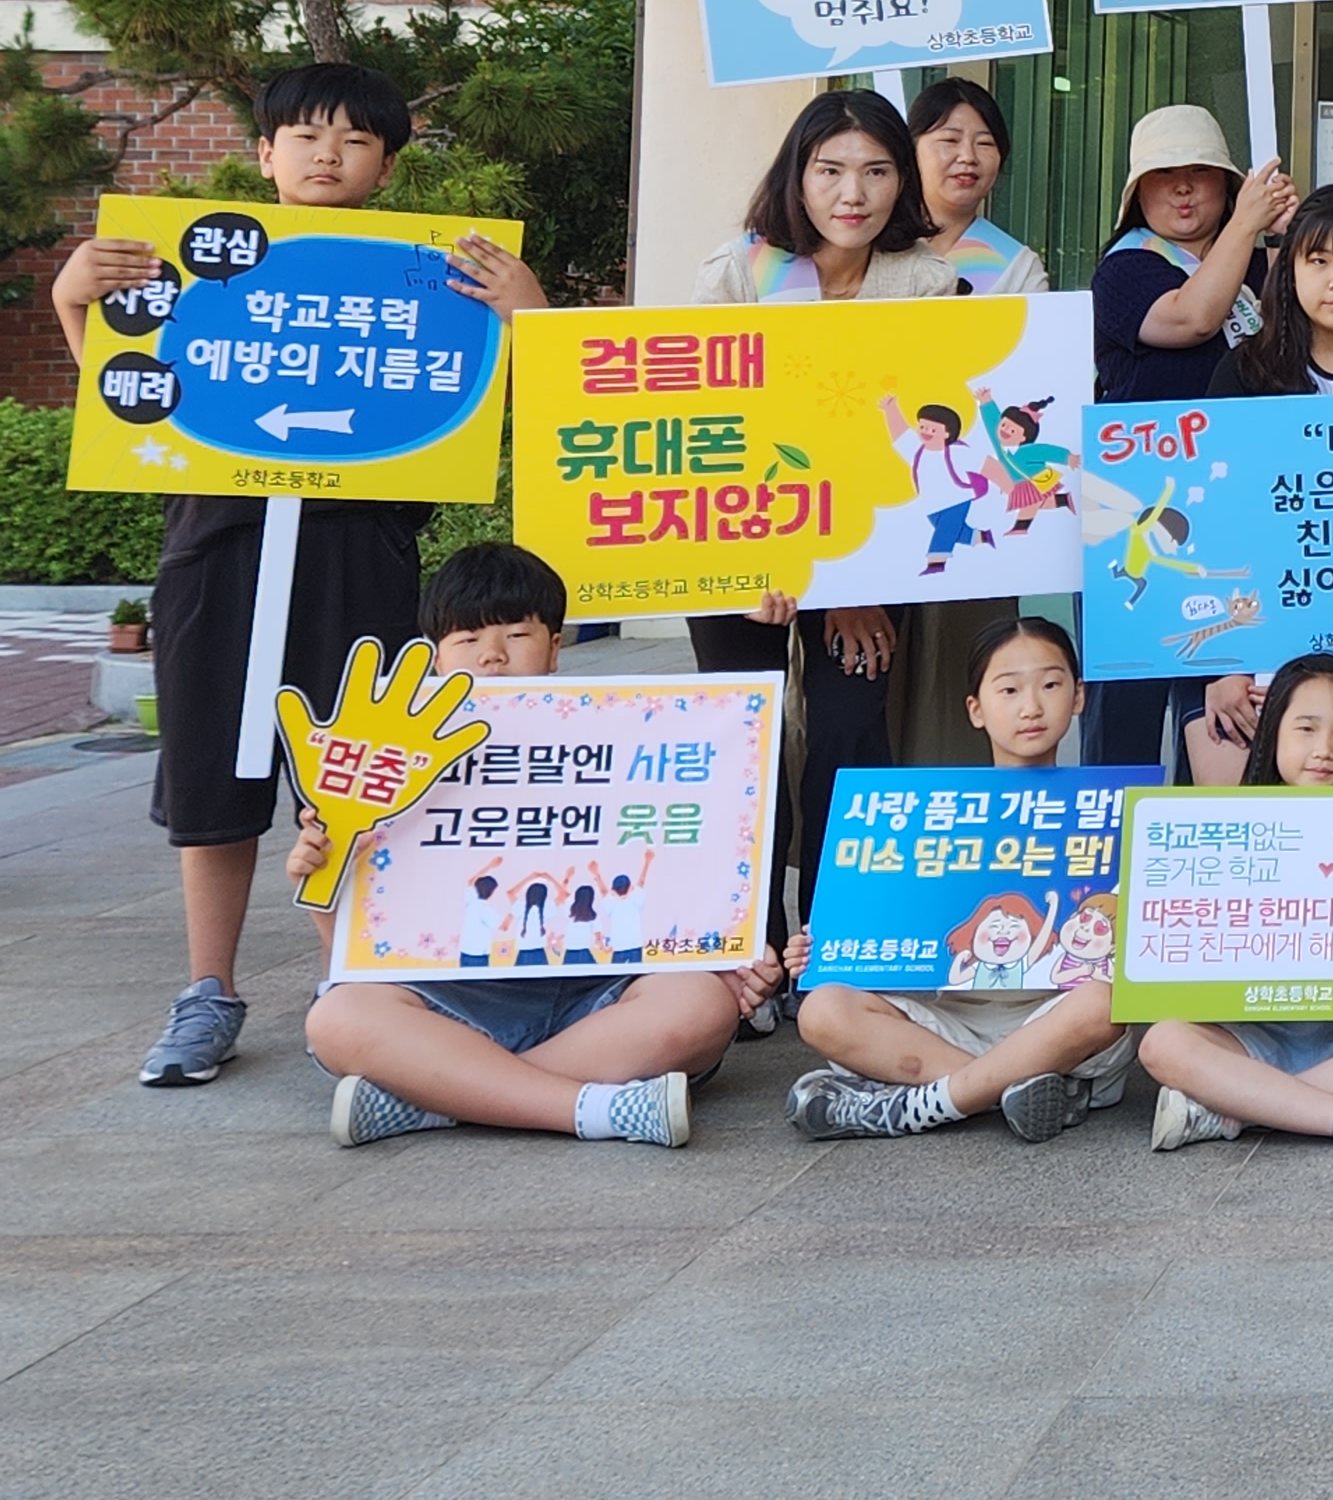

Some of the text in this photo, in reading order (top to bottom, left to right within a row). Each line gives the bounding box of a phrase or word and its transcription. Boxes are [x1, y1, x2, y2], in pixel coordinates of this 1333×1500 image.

[926, 23, 1032, 51] 상학초등학교
[190, 228, 260, 265] 관심
[105, 281, 178, 317] 사랑
[246, 290, 419, 338] 학교폭력
[187, 339, 463, 392] 예방의 지름길
[581, 333, 765, 394] 걸을때
[103, 371, 173, 407] 배려
[556, 415, 747, 482] 휴대폰
[1100, 411, 1207, 463] STOP
[233, 469, 341, 490] 상학초등학교
[586, 481, 831, 547] 보지않기
[576, 573, 771, 603] 상학초등학교 학부모회
[439, 742, 716, 786] 바른말엔 사랑
[420, 803, 702, 849] 고운말엔 웃음
[844, 789, 1123, 831] 사랑 품고 가는 말!
[1147, 822, 1303, 852] 학교폭력없는
[836, 836, 1114, 877] 미소 담고 오는 말!
[1143, 856, 1281, 887] 즐거운 학교
[1142, 898, 1333, 929] 따뜻한 말 한마디
[820, 938, 938, 960] 상학초등학교
[1138, 933, 1193, 963] 지금
[1198, 932, 1301, 962] 친구에게
[1244, 986, 1333, 1004] 상학초등학교
